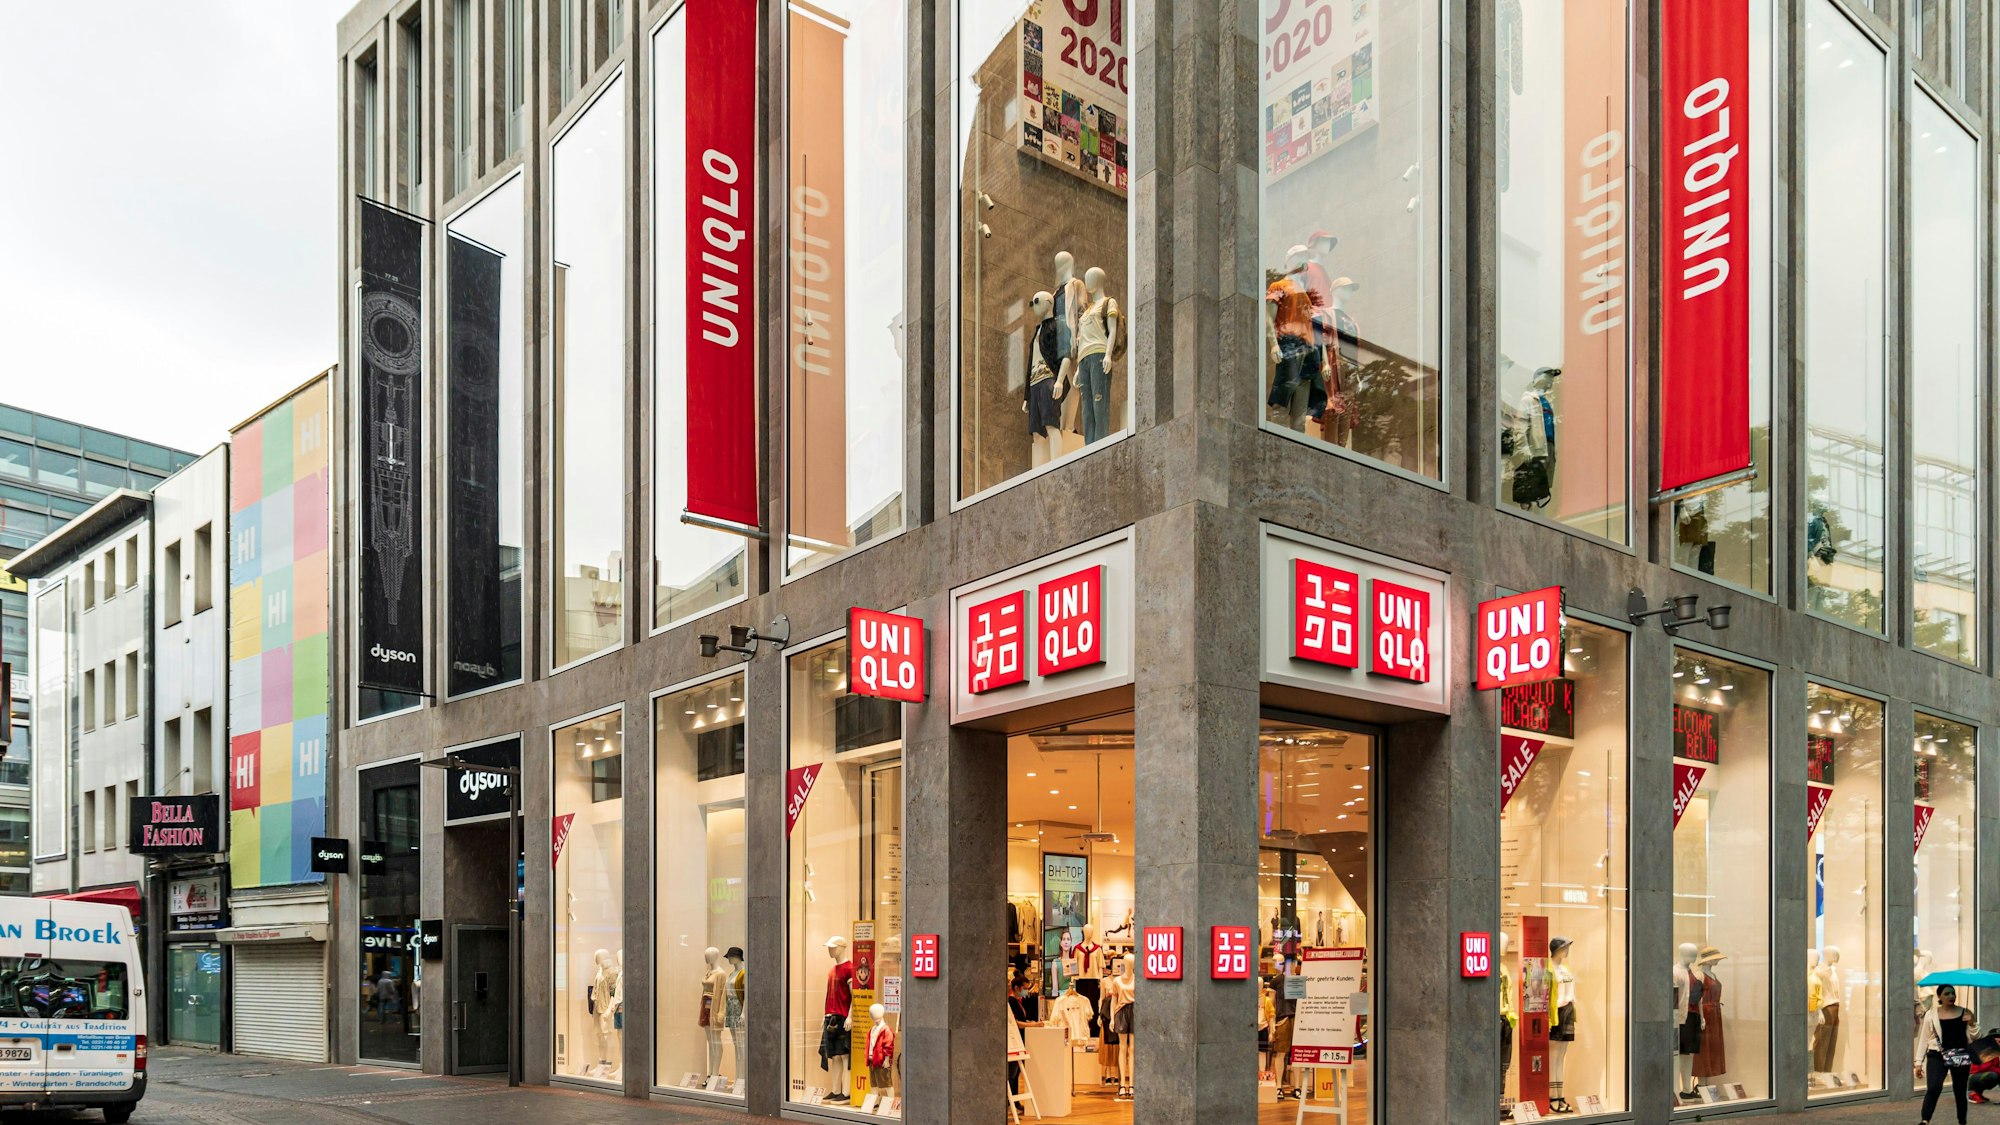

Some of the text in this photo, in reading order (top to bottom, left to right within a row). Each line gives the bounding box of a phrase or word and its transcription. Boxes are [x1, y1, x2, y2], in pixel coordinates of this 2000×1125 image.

[1684, 78, 1739, 300] UNIQLO
[702, 148, 745, 348] UNIQLO
[301, 411, 320, 456] HI
[237, 526, 255, 564] HI
[268, 590, 287, 628] HI
[1045, 581, 1089, 623] UNI
[1379, 592, 1420, 631] UNI
[1487, 600, 1545, 640] UNI
[371, 643, 416, 663] dyson
[860, 619, 910, 655] UNI
[1045, 620, 1093, 666] QLO
[1379, 631, 1424, 669] QLO
[860, 655, 915, 690] QLO
[1487, 638, 1550, 681] QLO
[236, 753, 254, 789] HI
[300, 738, 319, 777] HI
[1501, 740, 1534, 795] SALE
[460, 769, 508, 800] dyson
[788, 768, 814, 822] SALE
[1673, 768, 1698, 816] SALE
[151, 801, 194, 823] BELLA
[1807, 789, 1827, 832] SALE
[1914, 808, 1930, 847] SALE
[143, 825, 204, 847] FASHION
[553, 817, 571, 857] SALE
[318, 850, 343, 861] dyson
[1048, 865, 1083, 878] BH-TOP
[423, 933, 438, 945] dyson
[1147, 933, 1174, 951] UNI
[1466, 938, 1486, 954] UNI
[1147, 954, 1177, 975] QLO
[1466, 956, 1488, 973] QLO
[5, 1050, 29, 1058] 9876
[12, 1080, 68, 1088] Wintergärten
[857, 1075, 867, 1090] UT
[1322, 1082, 1334, 1090] UT
